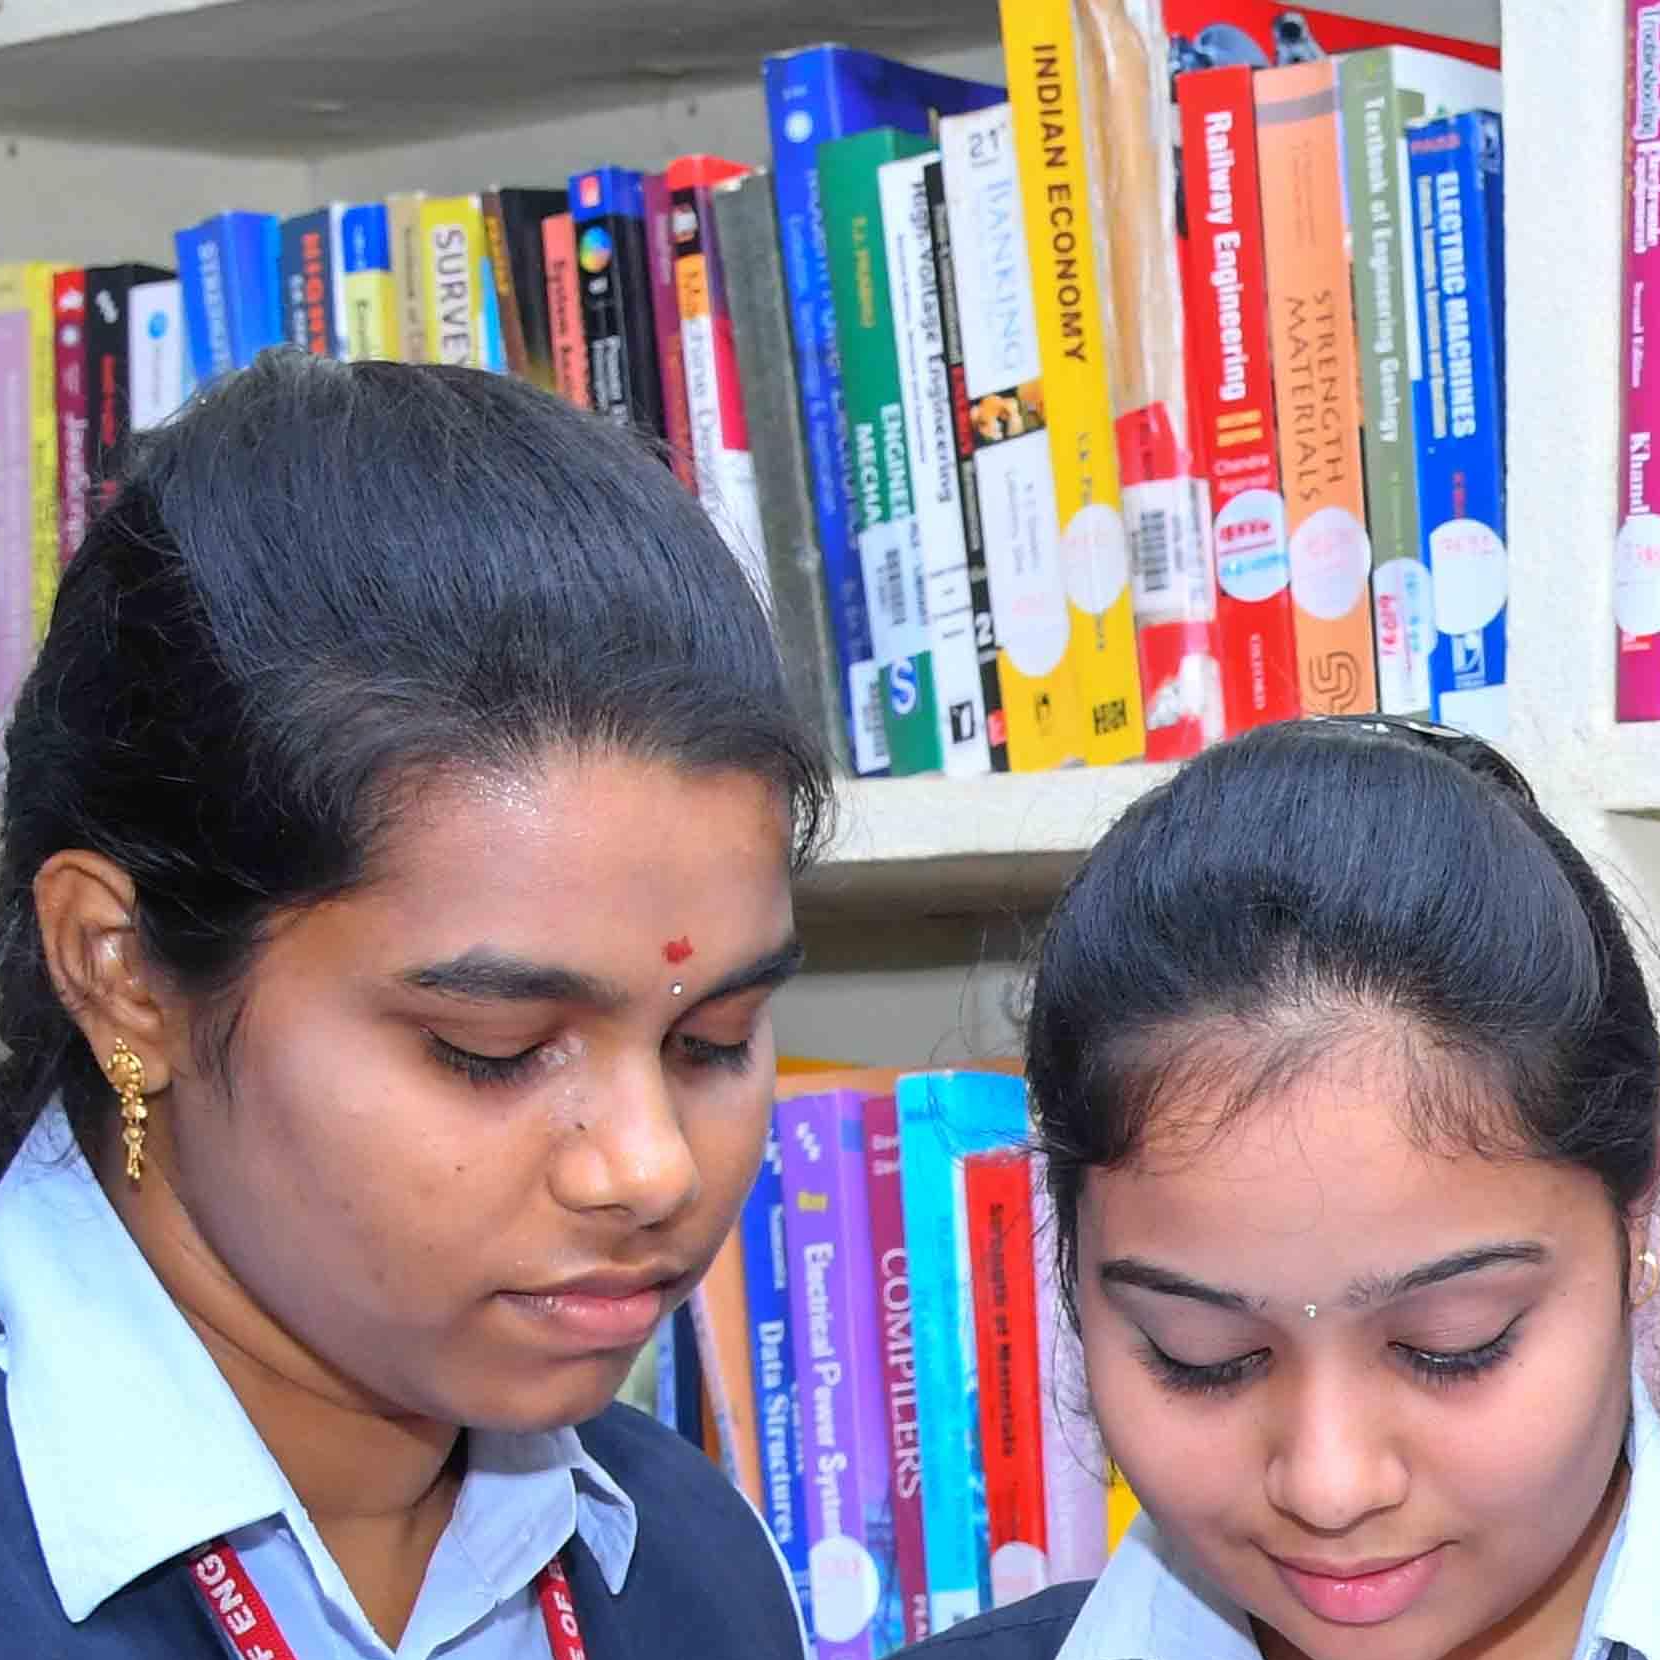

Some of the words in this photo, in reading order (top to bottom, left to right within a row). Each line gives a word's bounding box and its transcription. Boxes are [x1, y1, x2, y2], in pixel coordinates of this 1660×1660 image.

[1033, 44, 1068, 170] INDIAN
[1205, 111, 1235, 224] Railway
[1047, 186, 1086, 363] ECONOMY
[1437, 171, 1465, 295] ELECTRIC
[1210, 231, 1247, 400] Engineering
[1312, 290, 1342, 486] STRENGTH
[1446, 300, 1476, 438] MACHINES
[1285, 297, 1322, 501] MATERIALS
[759, 1322, 786, 1390] Data
[879, 1247, 923, 1500] COMPILERS
[764, 1394, 792, 1544] Structures
